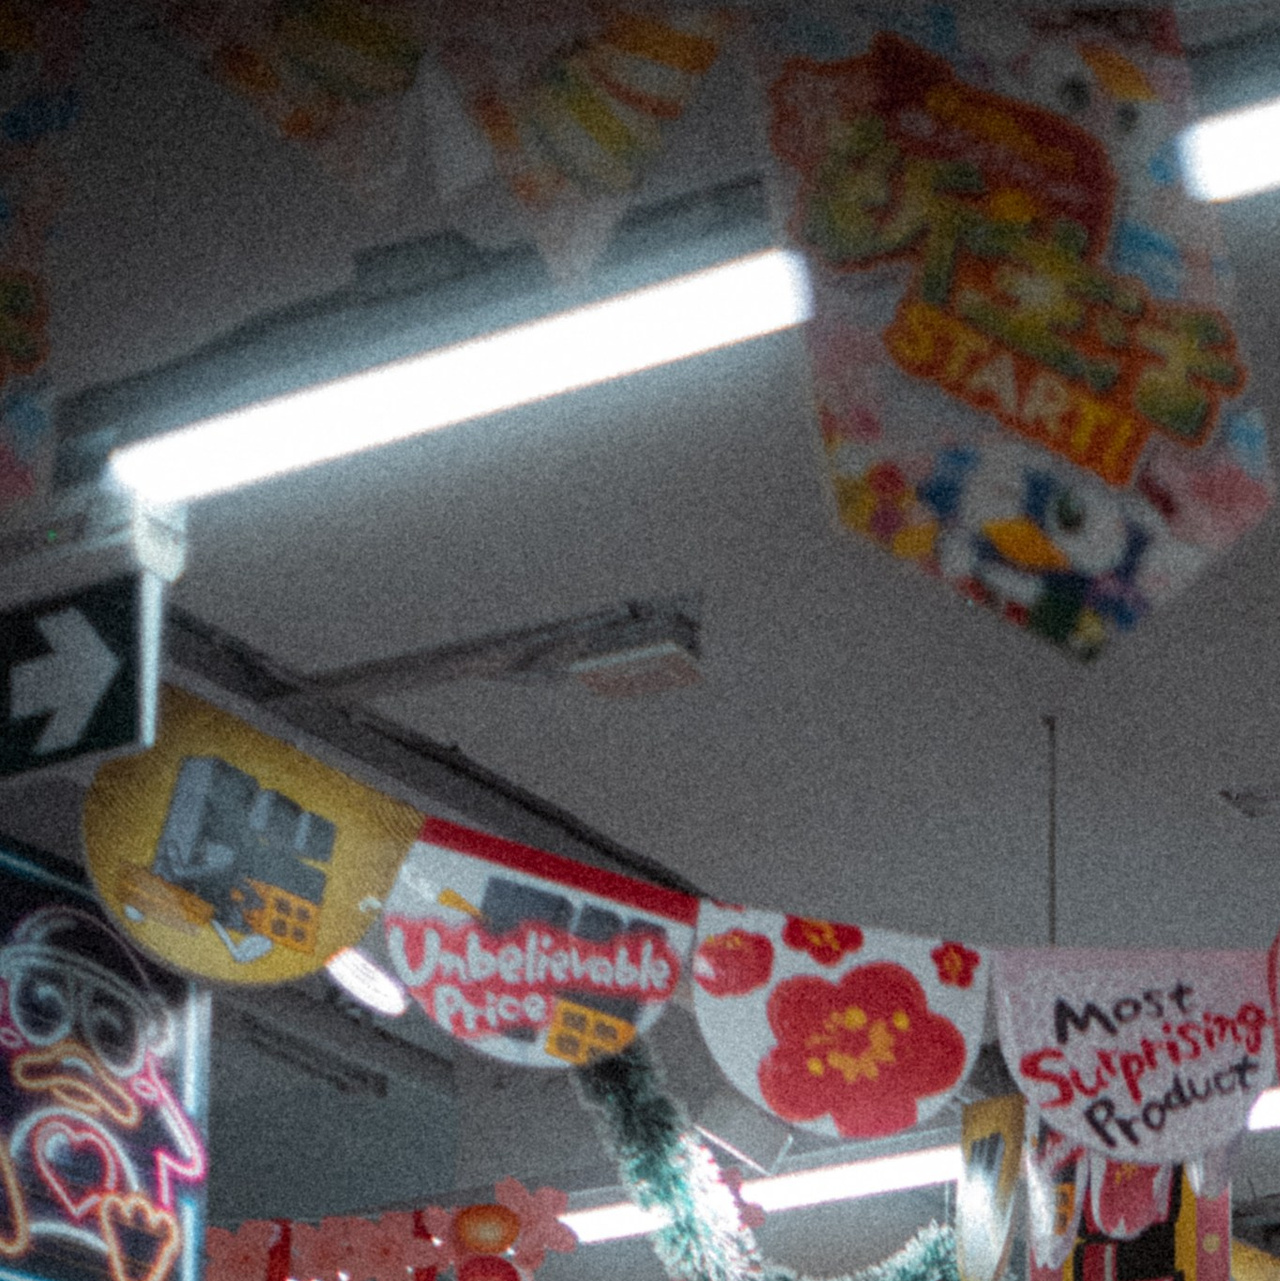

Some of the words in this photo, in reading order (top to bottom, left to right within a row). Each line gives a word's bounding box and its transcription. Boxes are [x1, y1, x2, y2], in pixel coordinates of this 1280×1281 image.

[404, 934, 673, 993] Unbelievable
[433, 990, 549, 1032] Price
[1054, 981, 1195, 1043] Most
[1020, 1003, 1267, 1105] Surprising
[1082, 1058, 1261, 1149] Product
